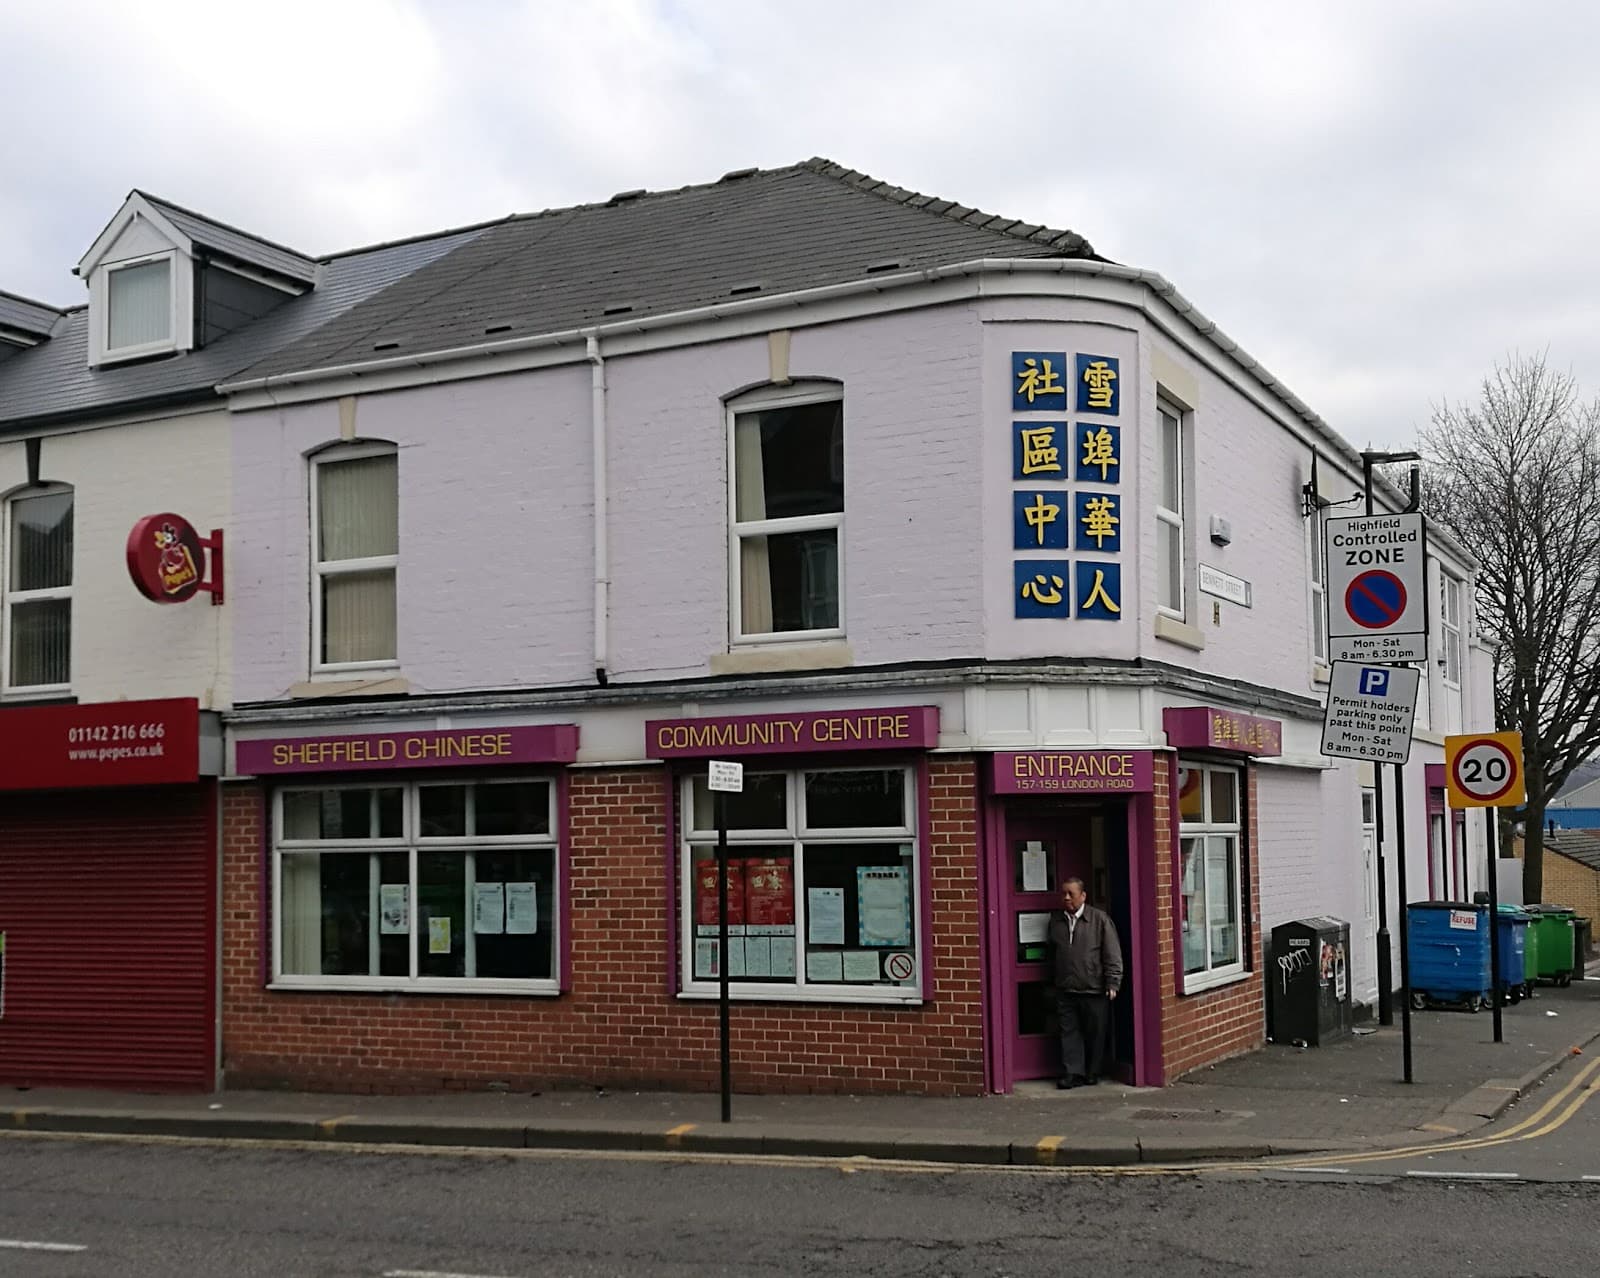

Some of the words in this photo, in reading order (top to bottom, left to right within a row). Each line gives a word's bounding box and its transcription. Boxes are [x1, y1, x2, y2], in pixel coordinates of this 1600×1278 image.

[1016, 358, 1065, 604] 社區中心
[1081, 360, 1121, 613] 雪埠華人
[1347, 518, 1400, 532] Highfield
[1333, 530, 1417, 547] Controlled
[1345, 547, 1405, 566] ZONE
[1353, 640, 1375, 648] Mon
[1383, 638, 1401, 647] Sat
[1341, 651, 1348, 660] 8
[1372, 649, 1397, 658] 6.30
[1399, 650, 1414, 658] pm
[1365, 671, 1385, 693] P
[1333, 696, 1368, 709] Permit
[1370, 700, 1411, 713] holders
[1336, 709, 1377, 721] parking
[1379, 713, 1403, 725] only
[68, 726, 108, 742] 01142
[112, 724, 136, 741] 216
[139, 722, 165, 739] 666
[658, 720, 804, 749] COMMUNITY
[812, 715, 910, 742] CENTRE
[1329, 719, 1353, 728] past
[1356, 721, 1377, 731] this
[1379, 724, 1407, 735] point
[1342, 732, 1364, 743] Mon
[1372, 735, 1392, 746] Sat
[68, 742, 165, 762] www.pepes.co.uk
[273, 739, 397, 765] SHEFFIELD
[404, 733, 512, 759] CHINESE
[1327, 742, 1334, 750] 8
[1335, 745, 1351, 753] am
[1359, 746, 1385, 756] 6.30
[1387, 750, 1403, 759] pm
[1014, 755, 1135, 777] ENTRANCE
[1463, 757, 1506, 783] 20
[1016, 780, 1059, 789] 157-159
[1061, 779, 1104, 789] LONDON
[1106, 779, 1135, 789] ROAD
